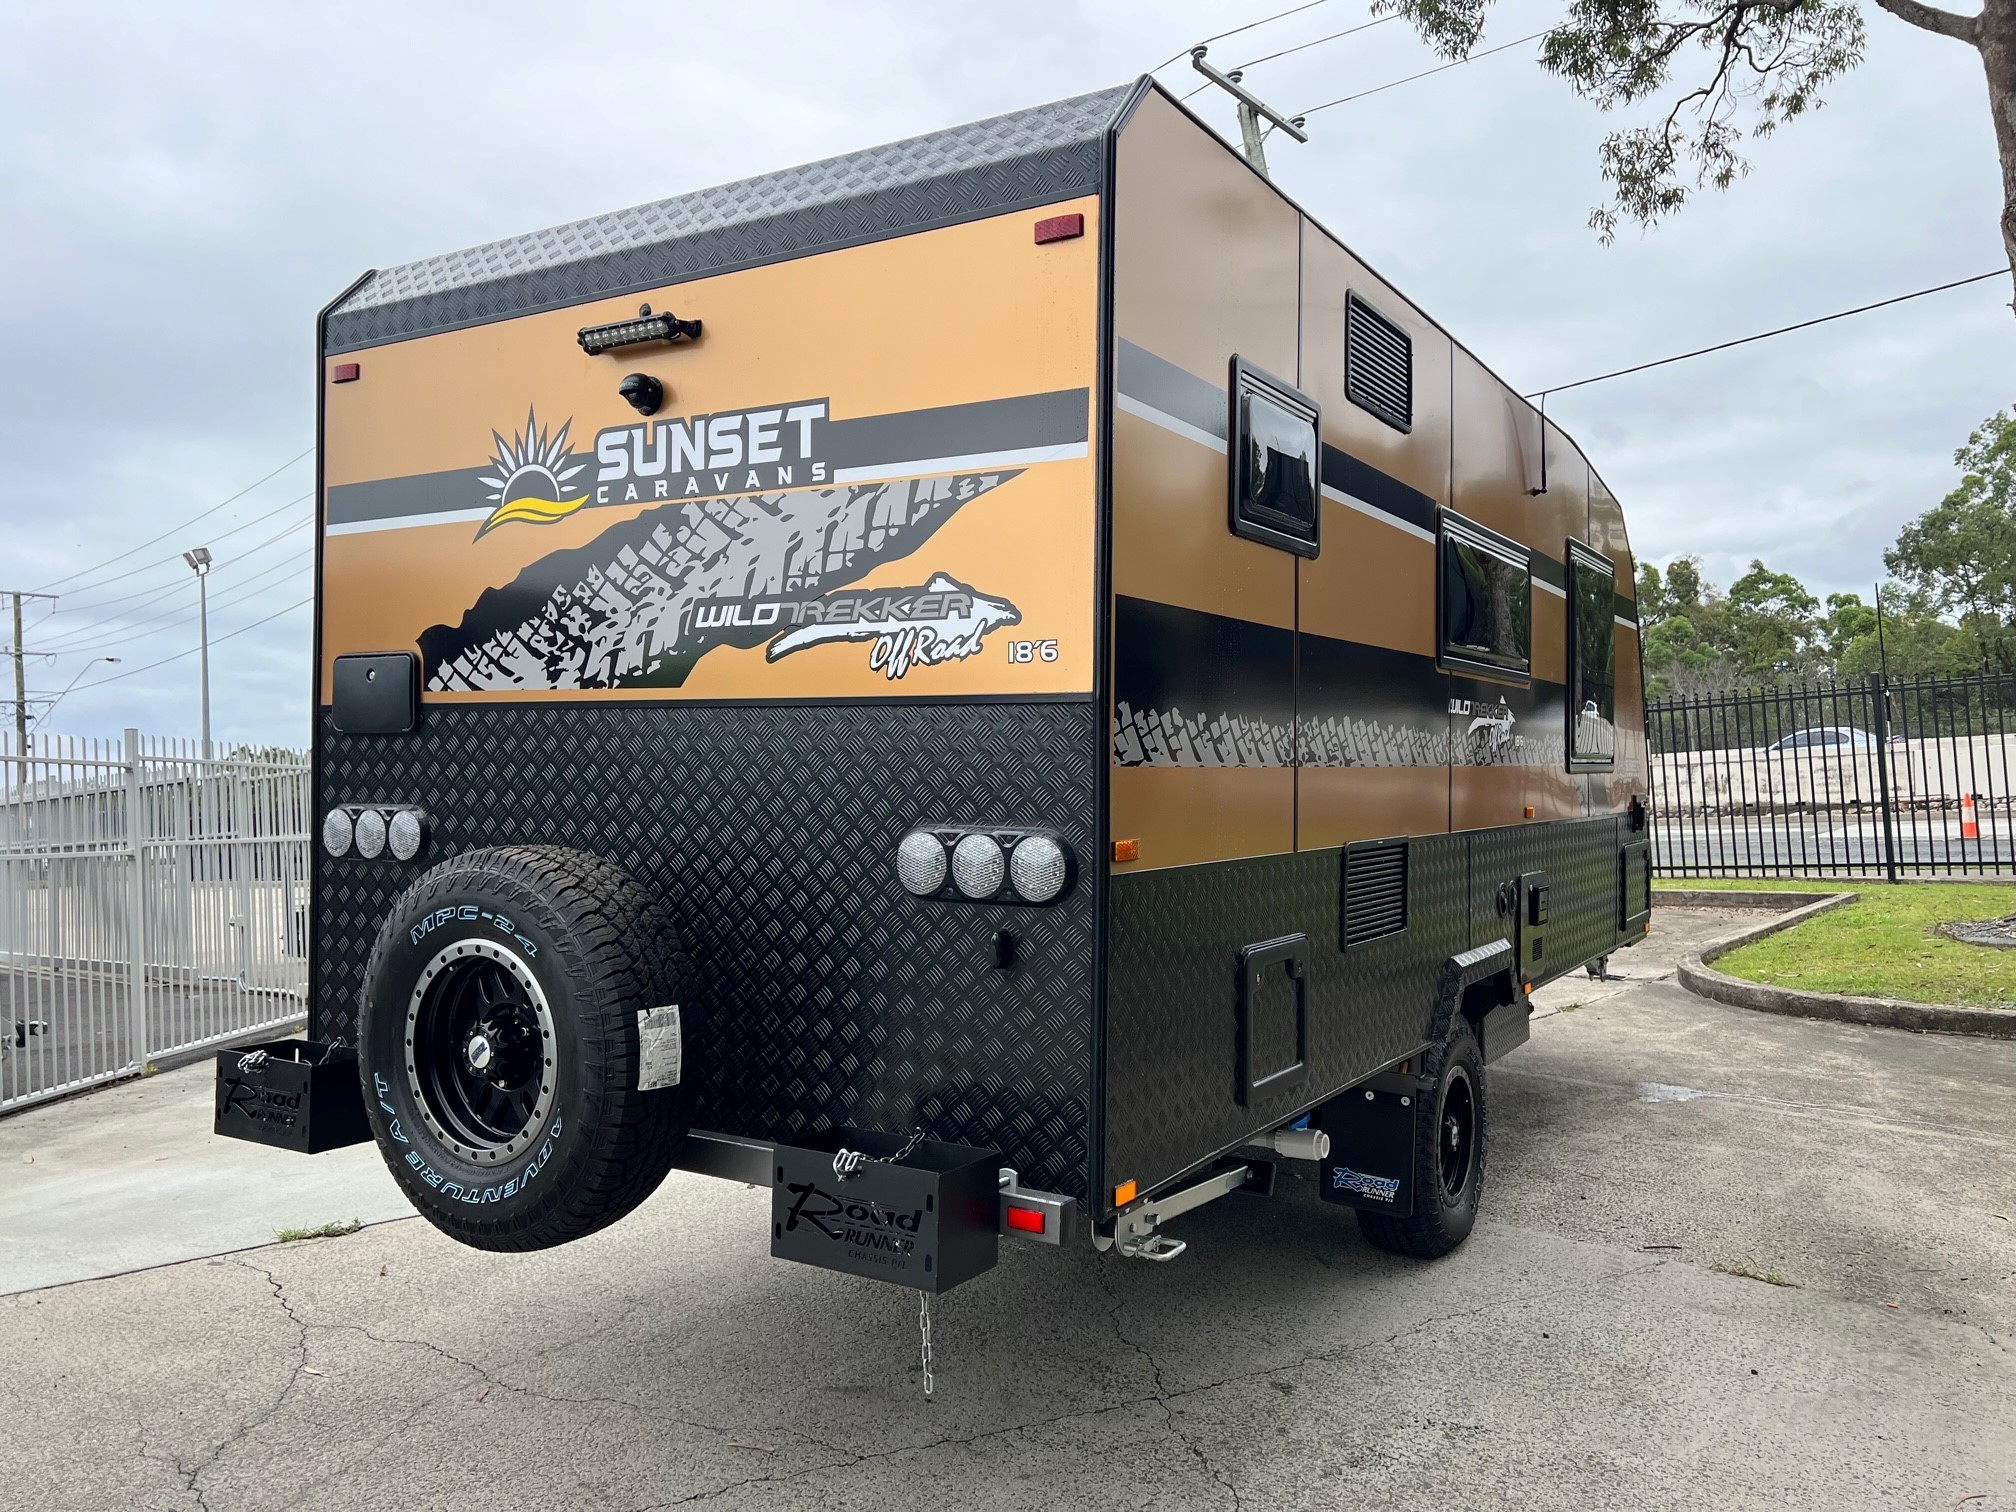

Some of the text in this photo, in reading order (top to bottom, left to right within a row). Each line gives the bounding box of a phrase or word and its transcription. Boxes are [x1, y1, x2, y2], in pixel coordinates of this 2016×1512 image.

[596, 403, 826, 482] SUNSET
[596, 461, 826, 504] CARAVANS
[870, 620, 982, 680] Off Road
[410, 905, 540, 958] MPC-24
[223, 1077, 302, 1119] Road
[374, 1072, 410, 1143] A/T
[404, 1106, 564, 1204] ADVENTURE
[1333, 1167, 1400, 1192] Road
[1362, 1186, 1395, 1199] RUNNER
[786, 1182, 923, 1240] Road
[844, 1228, 915, 1256] RUNNER
[848, 1249, 887, 1265] CHASSIS
